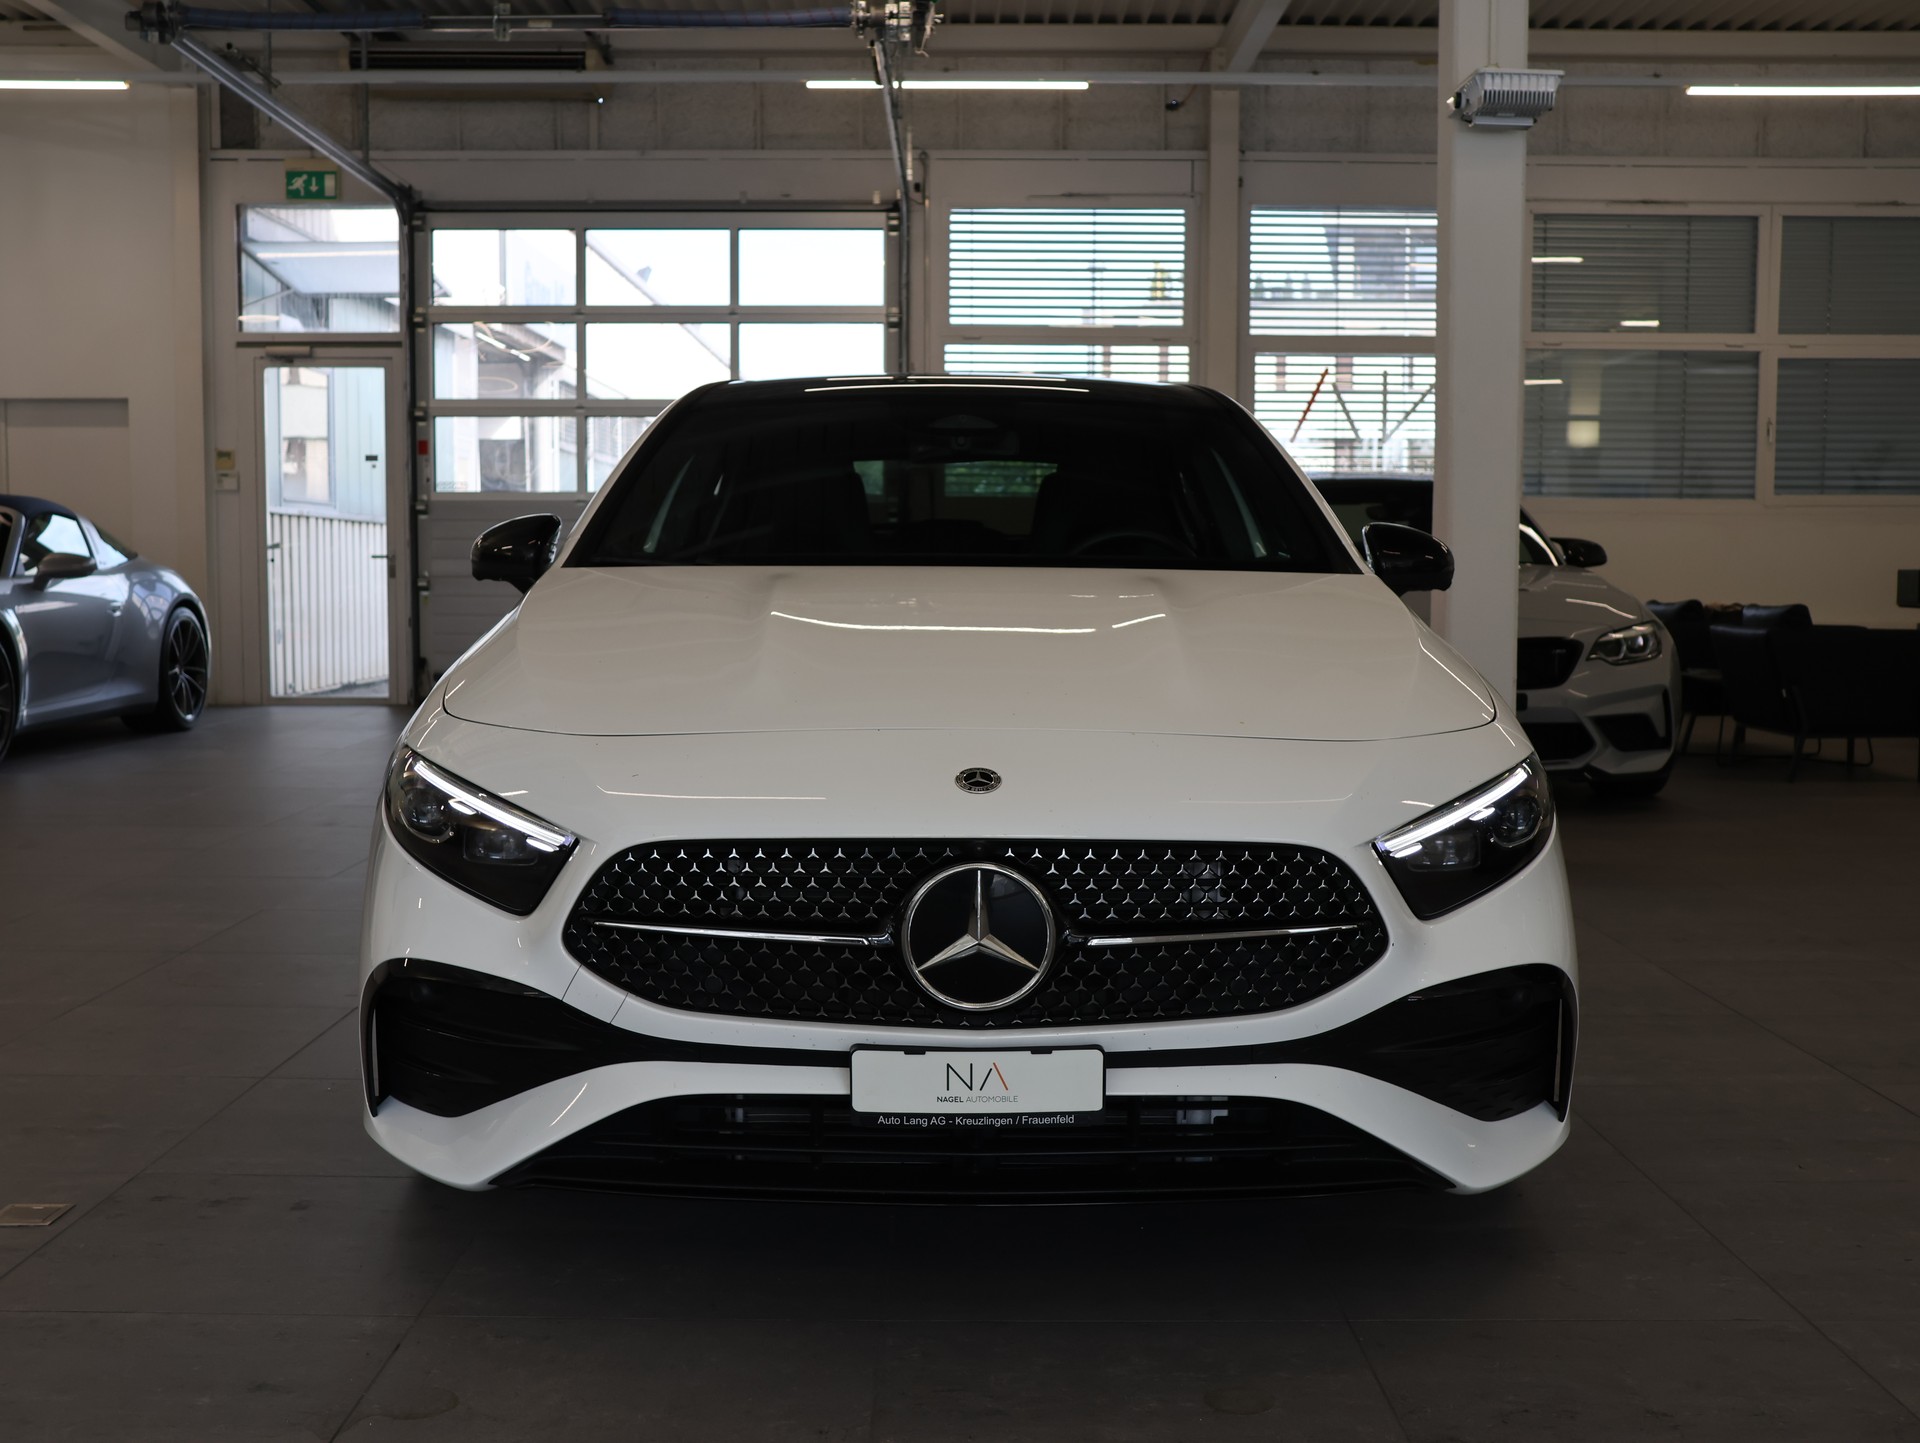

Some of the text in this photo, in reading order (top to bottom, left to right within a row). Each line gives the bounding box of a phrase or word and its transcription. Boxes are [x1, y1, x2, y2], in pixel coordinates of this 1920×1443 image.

[965, 1095, 1019, 1103] AUTOMOBILE
[877, 1115, 901, 1125] Auto
[903, 1116, 928, 1128] Lang
[930, 1116, 946, 1126] AG
[955, 1115, 1013, 1128] Kreuzlingen
[1021, 1114, 1075, 1125] Frauenfeld
